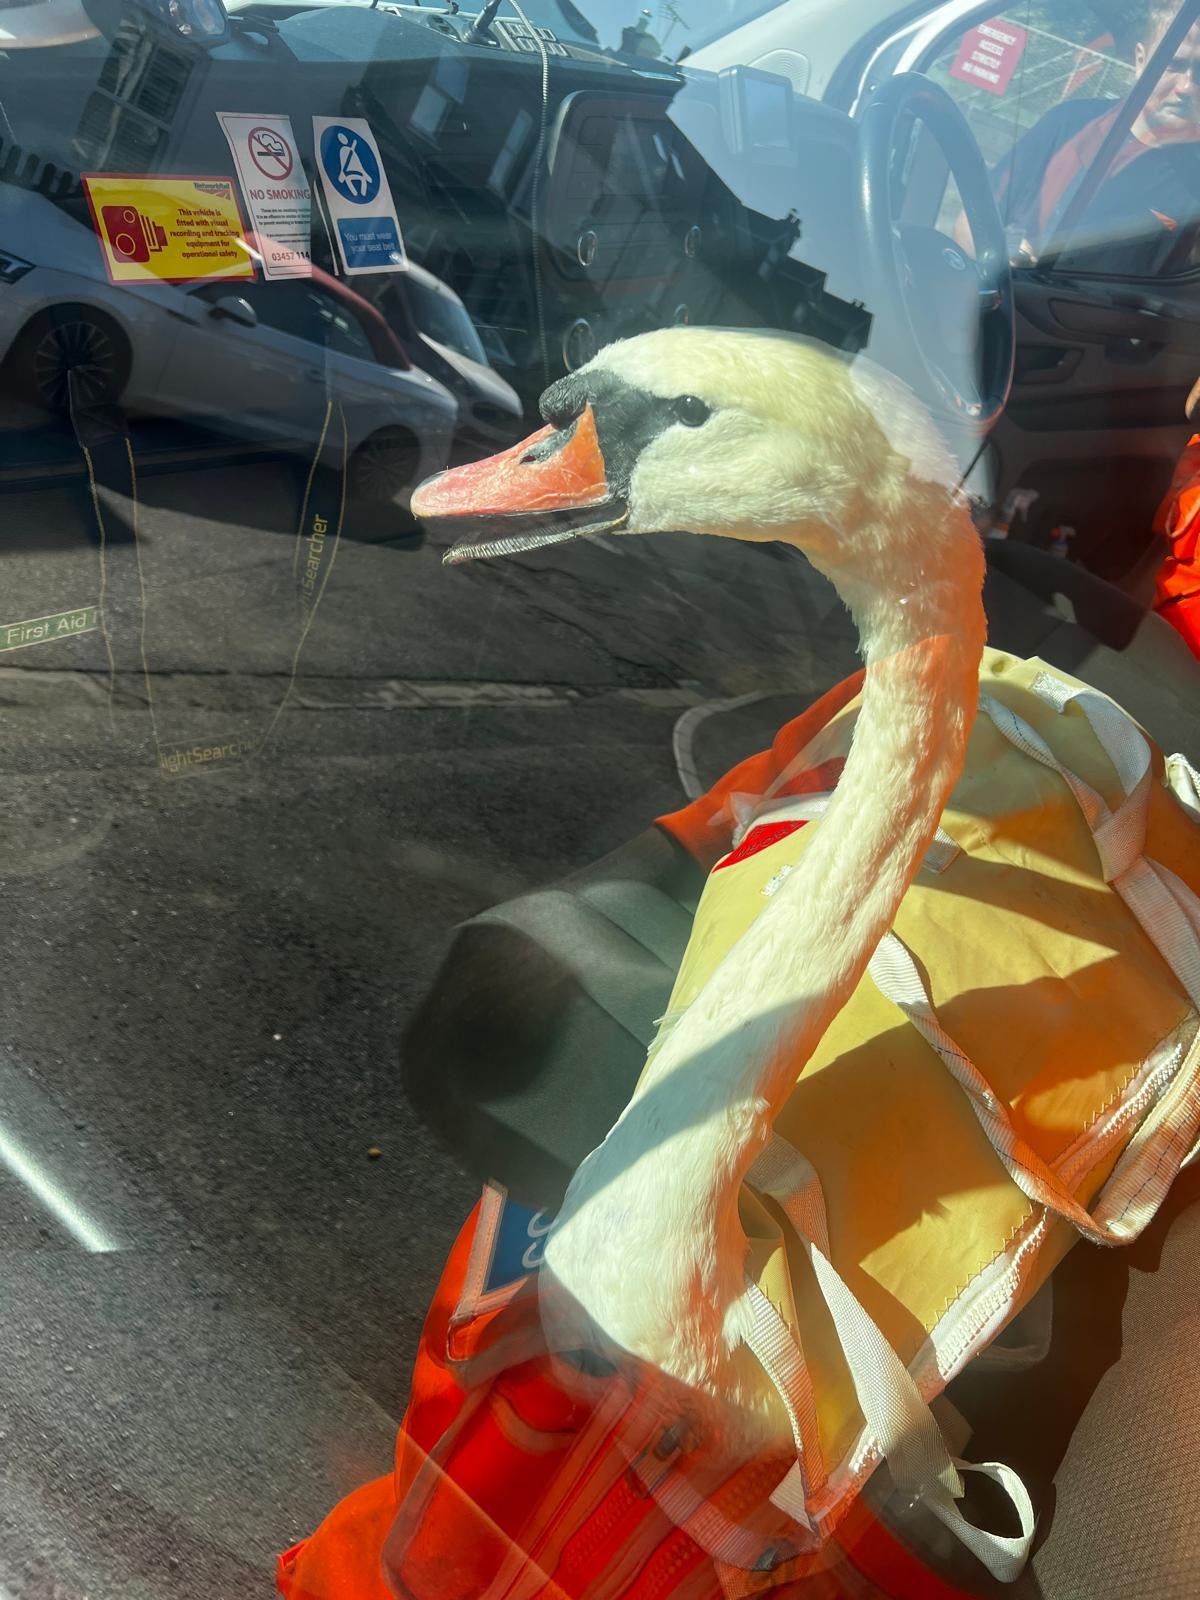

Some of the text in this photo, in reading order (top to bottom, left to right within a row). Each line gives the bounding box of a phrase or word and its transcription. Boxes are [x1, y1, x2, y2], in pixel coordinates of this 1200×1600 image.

[249, 188, 311, 201] NO SMOKING
[178, 208, 222, 217] This vehicle is
[176, 218, 229, 227] fitted with visual
[169, 230, 240, 239] recording and tracking
[343, 231, 392, 241] You must wear
[186, 240, 230, 249] equipment for
[351, 244, 366, 255] your
[367, 243, 382, 252] seat
[182, 250, 238, 259] operational safety
[271, 251, 311, 261] 03457 114
[7, 621, 50, 645] First
[57, 611, 87, 633] Aid
